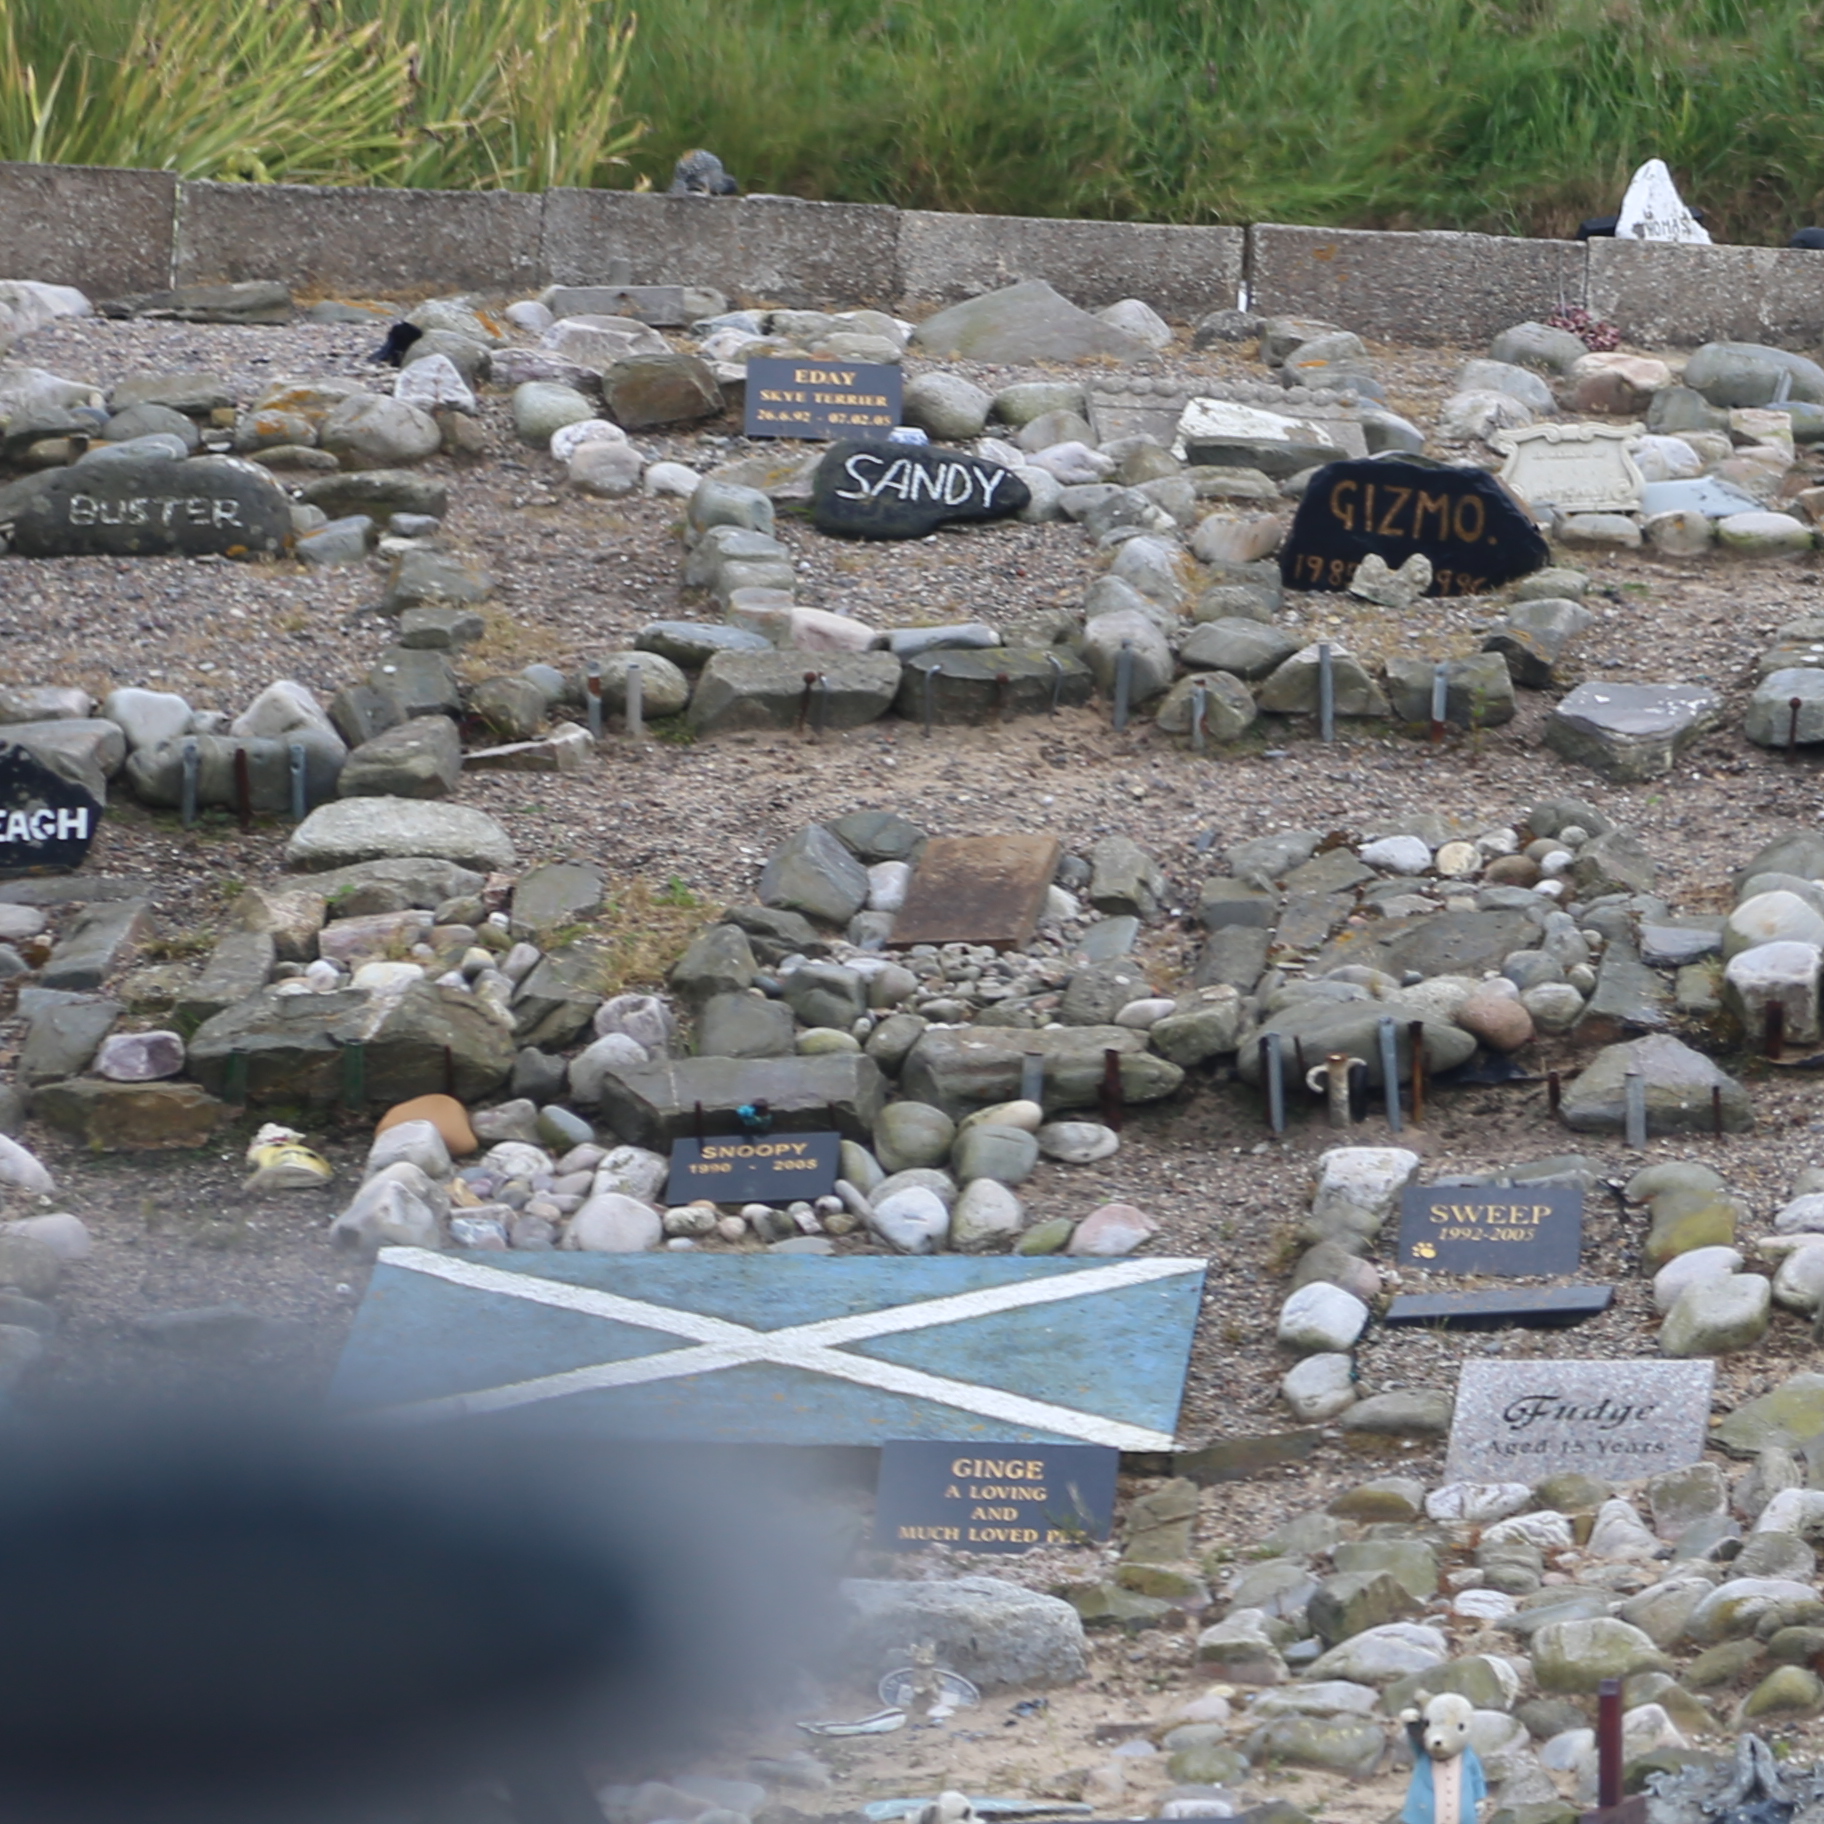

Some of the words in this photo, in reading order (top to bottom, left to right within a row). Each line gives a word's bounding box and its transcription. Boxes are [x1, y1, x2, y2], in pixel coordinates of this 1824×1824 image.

[794, 368, 857, 386] EDAY
[760, 389, 807, 404] SKYE
[813, 392, 888, 407] TERRIER
[835, 454, 1005, 508] SANDY
[69, 493, 243, 529] BUSTER
[702, 1142, 808, 1159] SNOOPY
[1429, 1204, 1553, 1225] SWEEP
[1438, 1226, 1537, 1242] 1992-2005
[1502, 1394, 1657, 1430] Fudge
[1486, 1439, 1548, 1457] Aged
[1597, 1439, 1666, 1455] Years
[952, 1458, 1045, 1480] GINGE
[944, 1484, 962, 1499] A
[969, 1484, 1048, 1502] LOVING
[971, 1506, 1020, 1522] AND
[898, 1525, 960, 1542] MUCH
[968, 1527, 1039, 1544] LOVED
